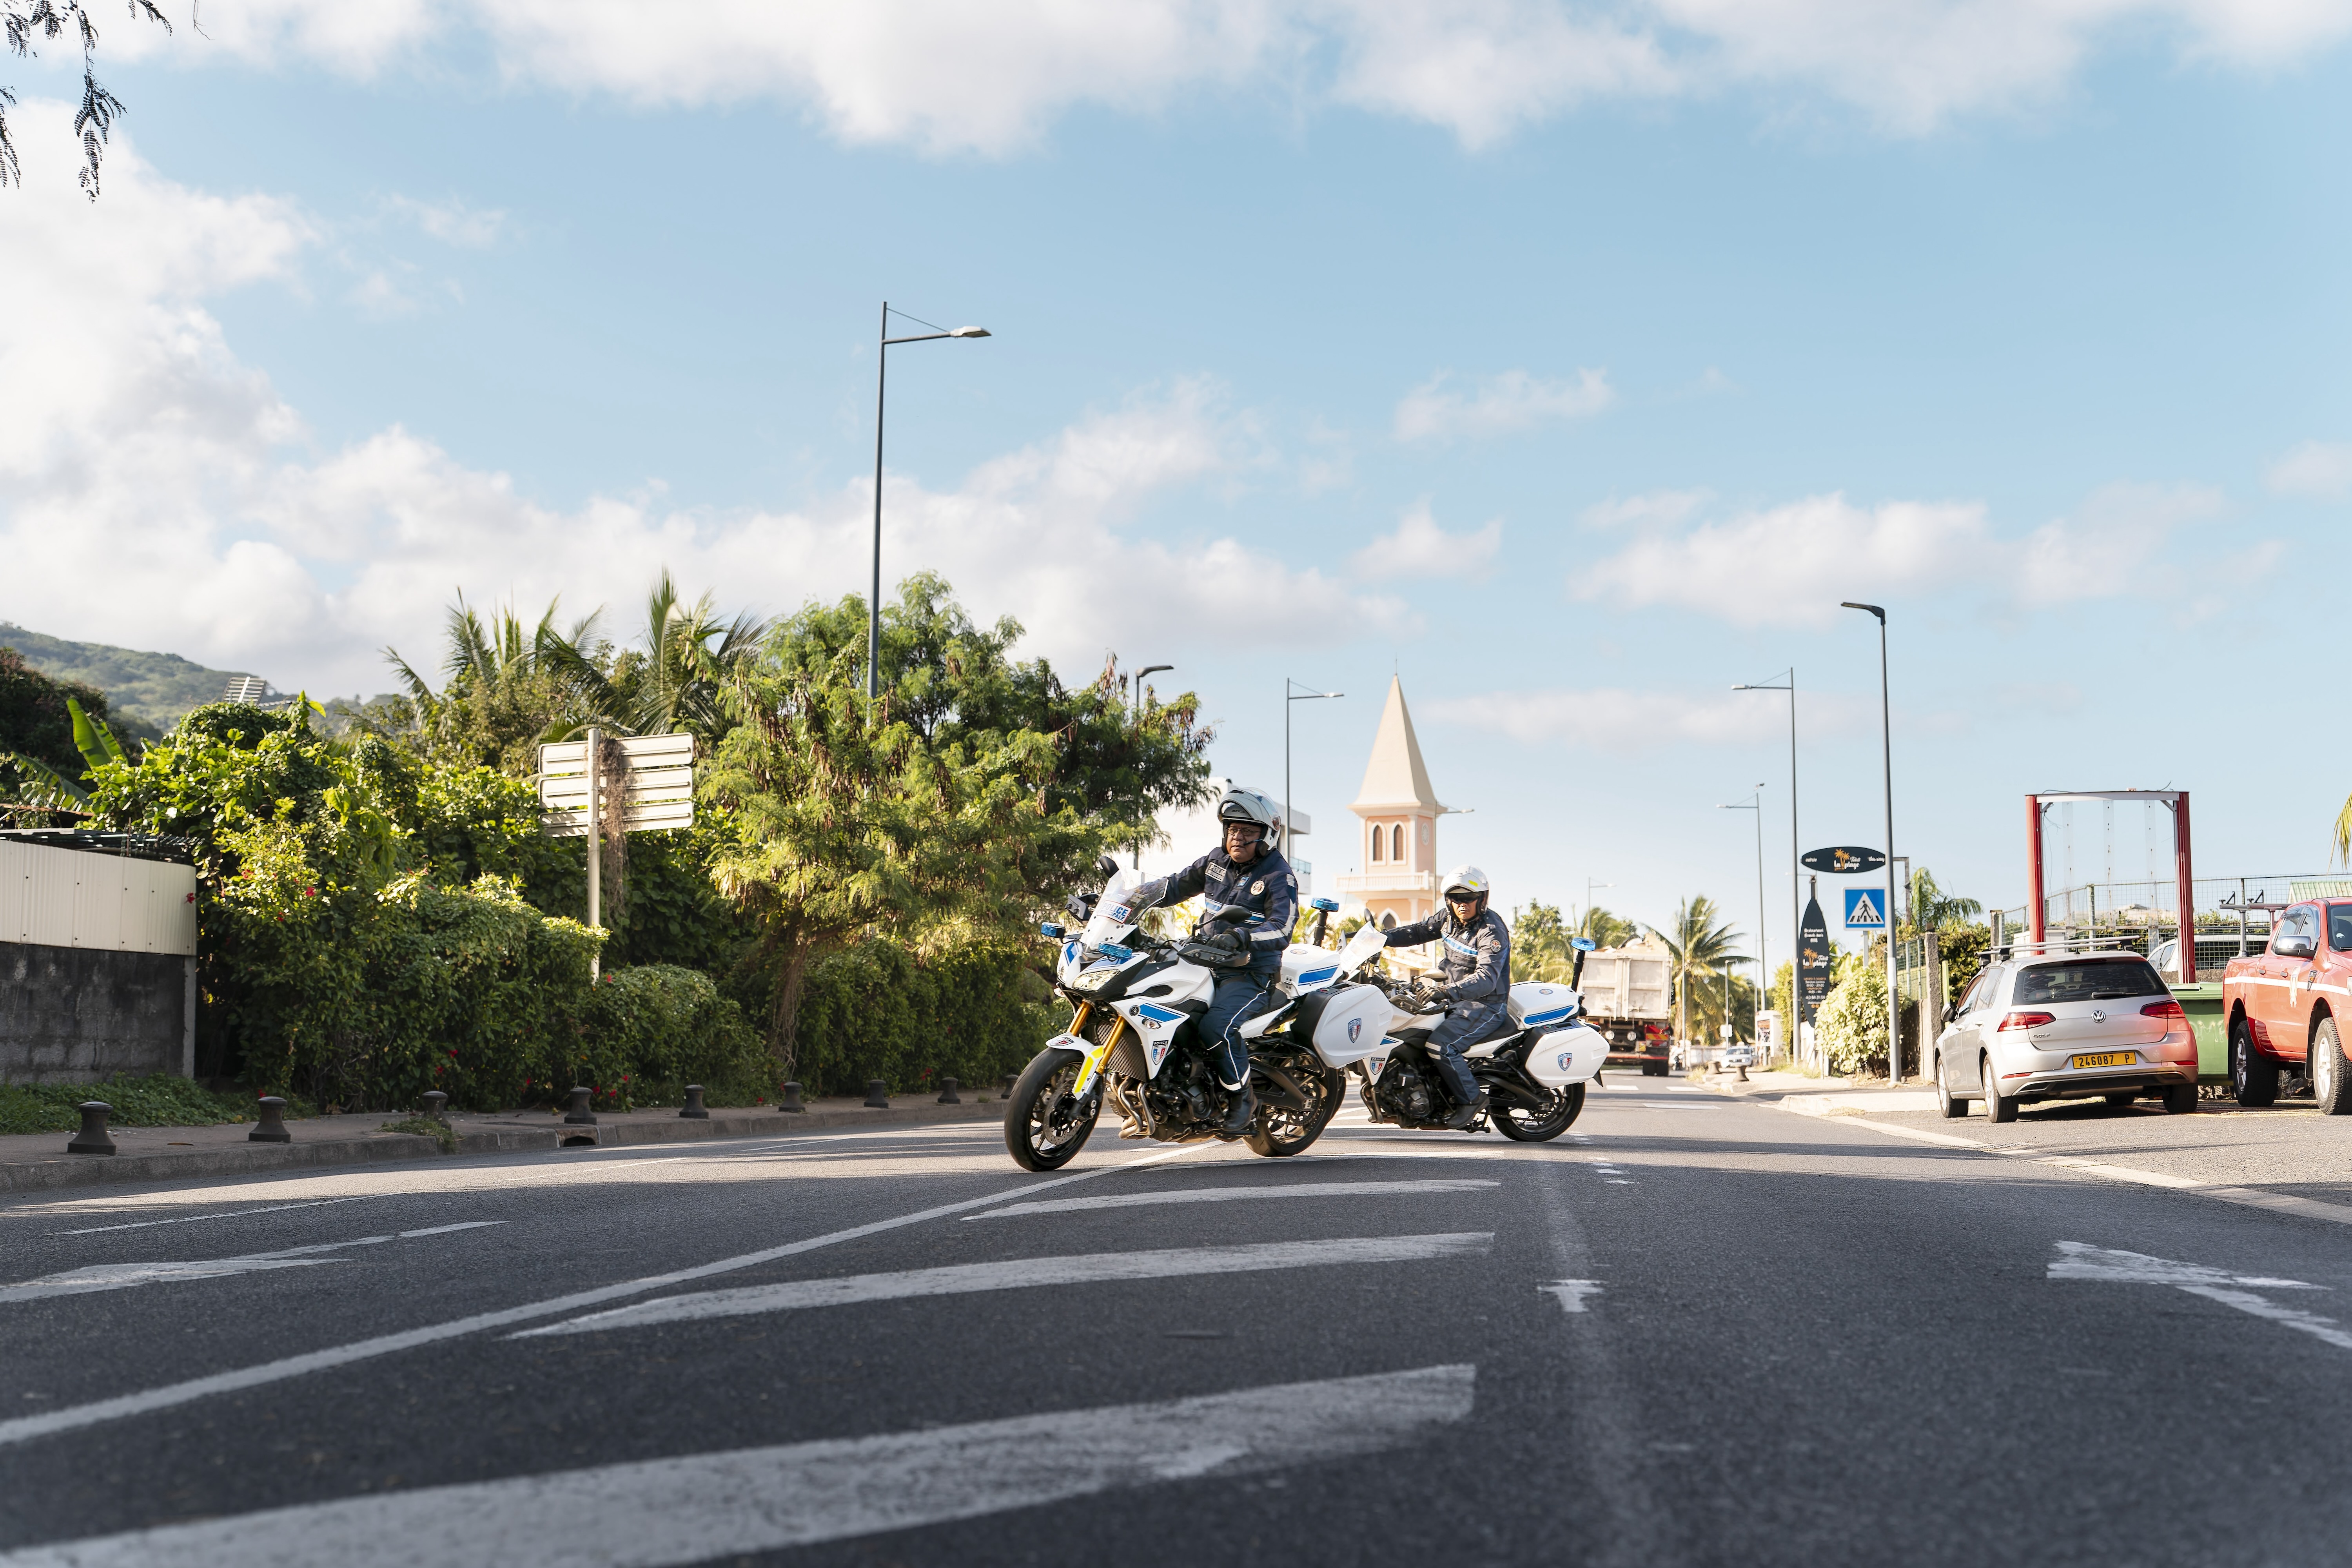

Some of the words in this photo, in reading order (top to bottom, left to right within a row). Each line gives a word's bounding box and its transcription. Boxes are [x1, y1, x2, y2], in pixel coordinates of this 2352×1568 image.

[1102, 903, 1129, 917] POLICE
[2079, 1055, 2114, 1067] 246087
[2125, 1054, 2129, 1063] P
